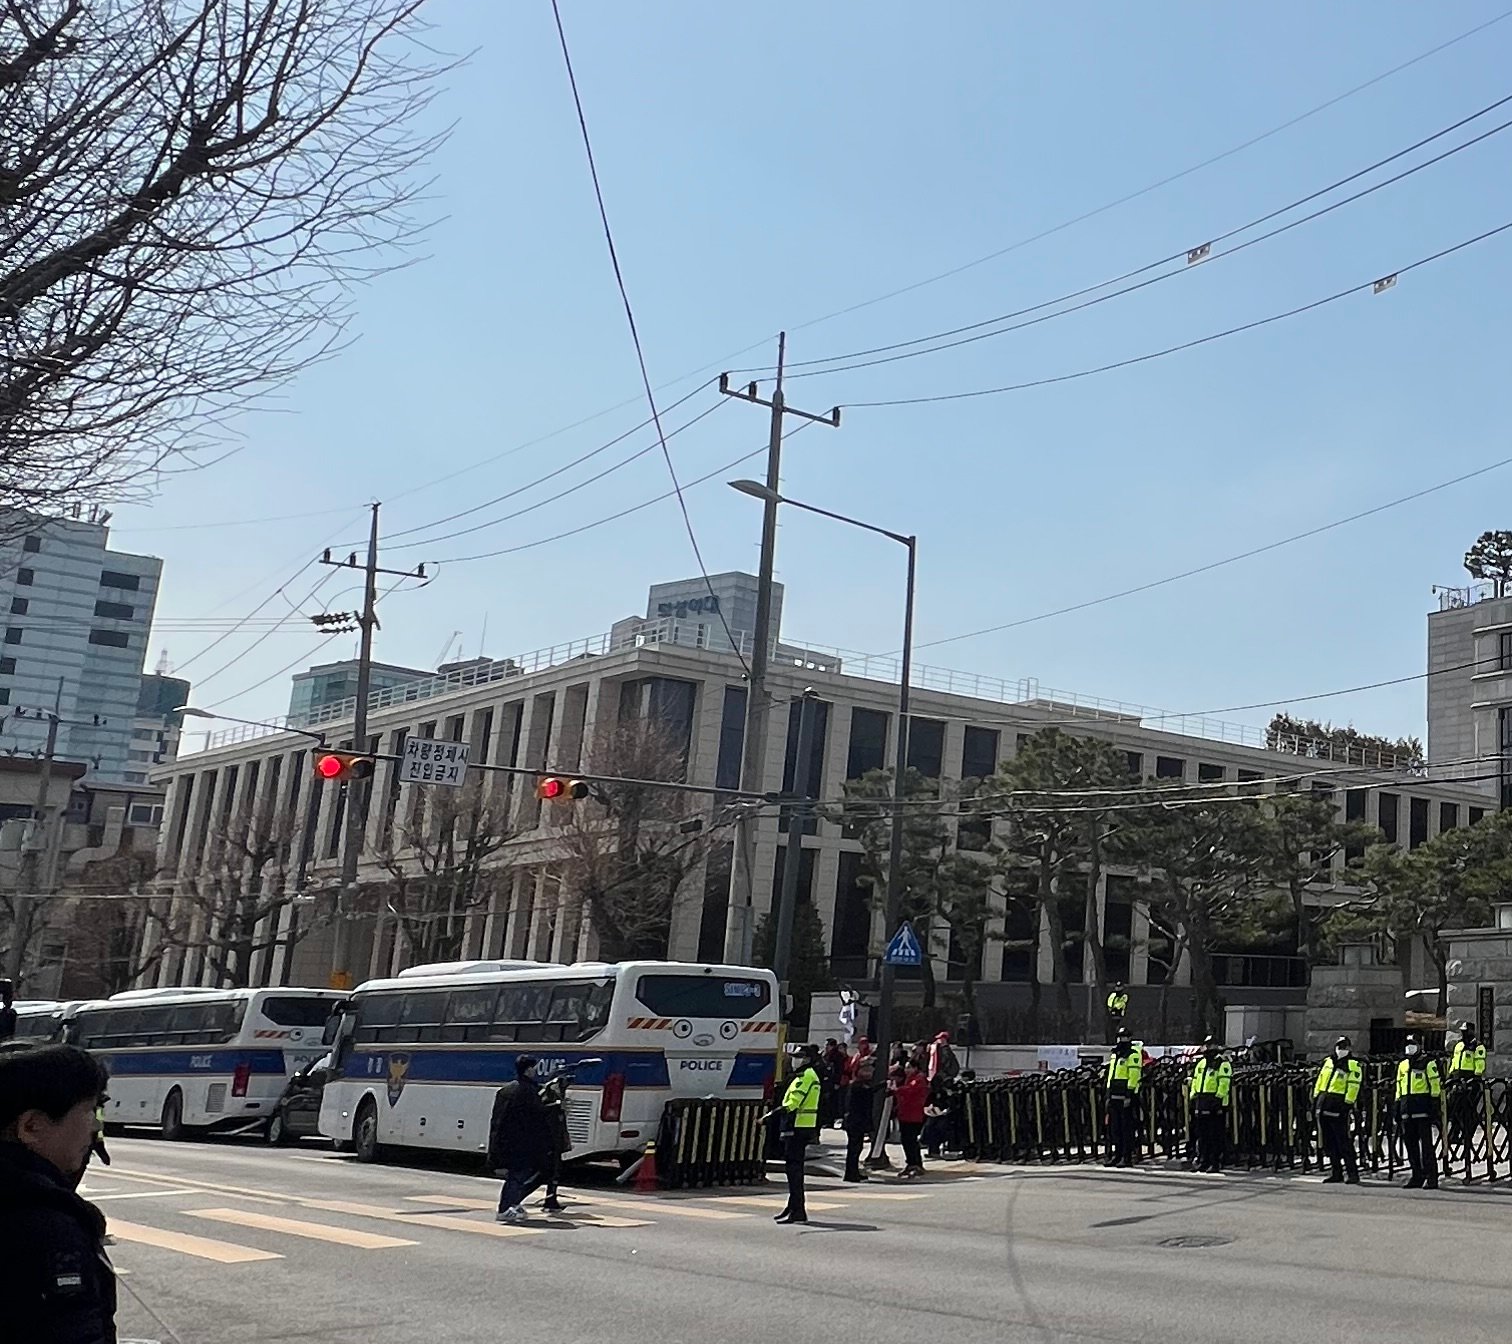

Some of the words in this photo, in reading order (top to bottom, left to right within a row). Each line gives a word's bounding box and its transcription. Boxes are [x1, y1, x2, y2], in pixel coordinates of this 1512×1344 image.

[408, 741, 469, 764] 차량정체시
[410, 761, 459, 783] 진입금지
[680, 1060, 723, 1071] POLICE
